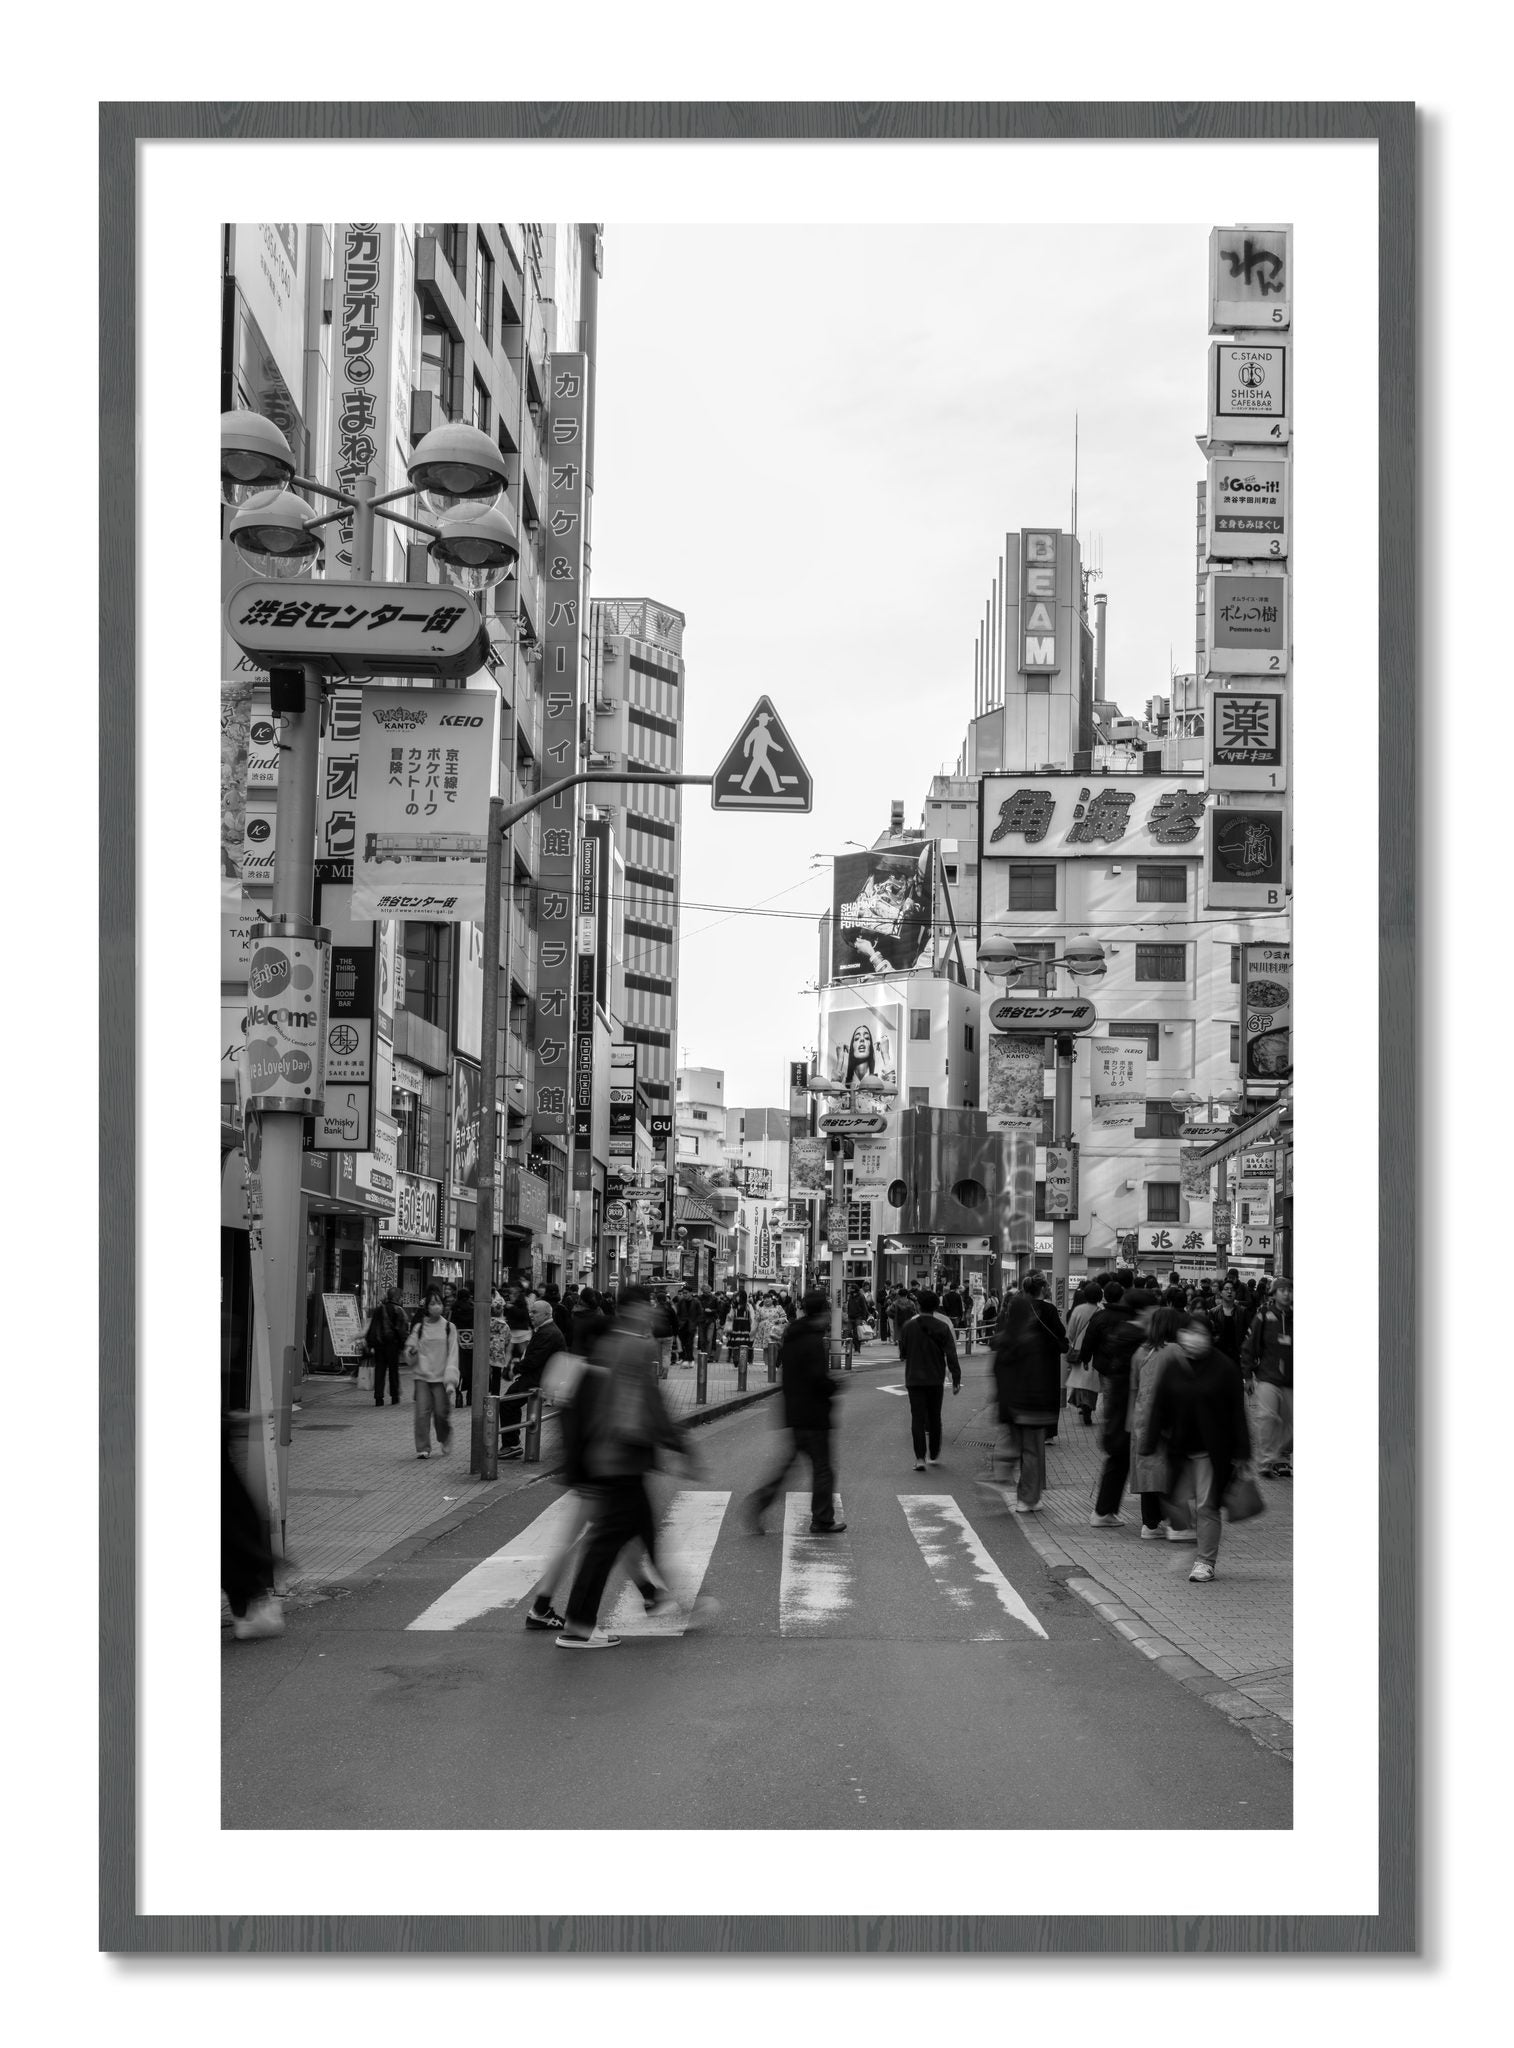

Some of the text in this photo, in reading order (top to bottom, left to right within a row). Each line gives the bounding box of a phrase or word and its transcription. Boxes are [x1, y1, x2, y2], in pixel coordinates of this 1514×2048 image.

[342, 231, 380, 357] カラオケ
[1272, 309, 1283, 323] 5
[1231, 351, 1272, 361] C.STAND
[1231, 389, 1272, 399] SHISHA
[1231, 399, 1272, 407] CAFE&BAR
[1271, 424, 1281, 438] 4
[1230, 478, 1279, 493] Goo-it!
[1224, 496, 1276, 504] 渋谷宇田川町店
[1219, 519, 1280, 530] 全身もみほぐし
[1270, 540, 1280, 555] 3
[1026, 533, 1056, 666] BEAM
[239, 599, 467, 635] 渋谷センター街
[1219, 604, 1279, 623] ポムの樹
[1269, 656, 1280, 670] 2
[384, 722, 416, 730] KANTO
[439, 715, 484, 728] KEIO
[1222, 700, 1269, 747] 薬
[247, 752, 280, 769] ind
[1217, 749, 1275, 763] マツモトキヨシ
[388, 747, 404, 787] 冒険へ
[251, 773, 274, 781] 渋谷店
[405, 747, 422, 816] カントーの
[424, 747, 441, 816] ポケパーク
[443, 749, 460, 803] 京王線で
[1268, 773, 1277, 787] 1
[990, 788, 1208, 844] 角海老
[1217, 823, 1273, 868] 一蘭
[242, 850, 275, 867] ind
[247, 871, 270, 879] 渋谷店
[584, 842, 592, 910] kimono hearts
[377, 896, 459, 908] 渋谷センター街
[1268, 890, 1278, 904] B
[251, 959, 288, 990] Enjoy
[336, 964, 356, 972] THIRD
[1248, 962, 1289, 974] 四川料理
[537, 893, 569, 1116] カラオケ館
[247, 1004, 318, 1028] Welcome
[996, 1006, 1090, 1019] 渋谷センター街
[1247, 1014, 1274, 1033] 6F
[263, 1058, 291, 1075] Lovely
[292, 1058, 311, 1072] Day!
[324, 1117, 355, 1128] Whisky
[652, 1121, 671, 1131] GU
[324, 1126, 343, 1135] Bank
[1182, 1127, 1235, 1135] 渋谷センター街
[420, 1190, 437, 1235] 190
[760, 1228, 769, 1267] BEER
